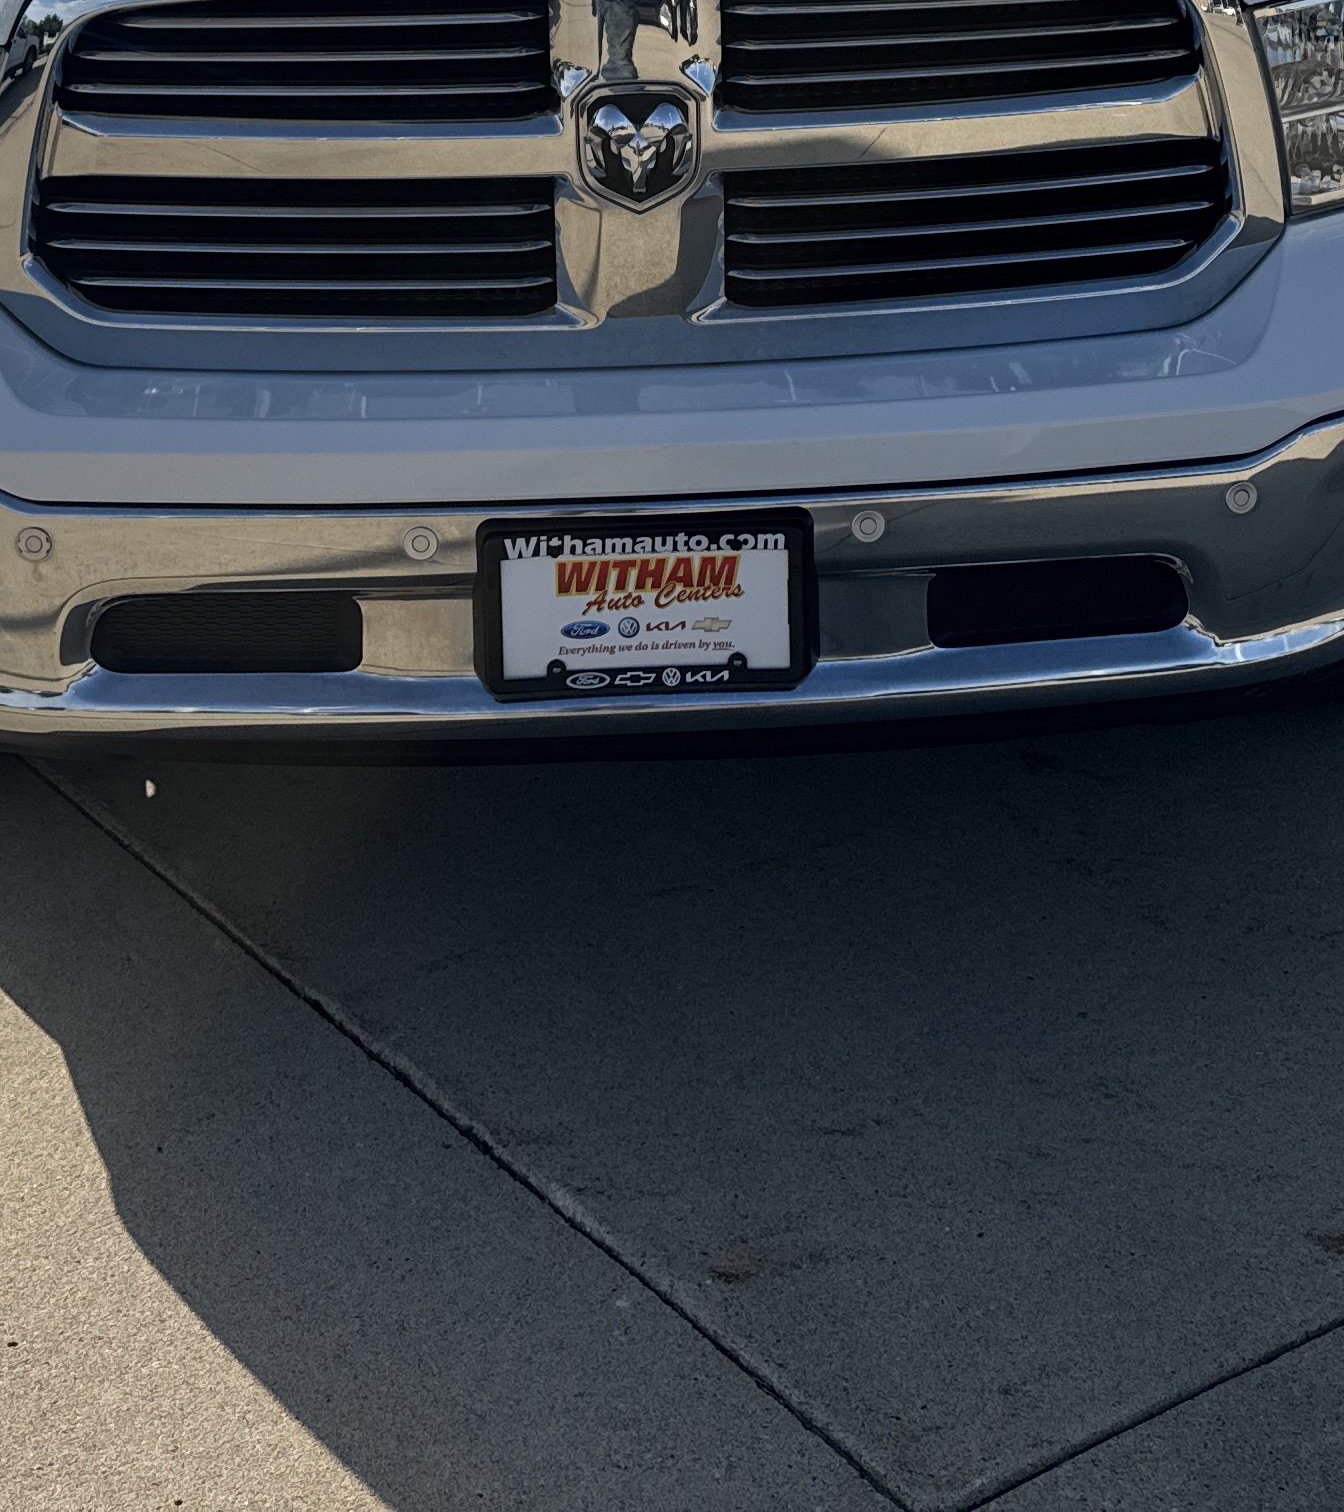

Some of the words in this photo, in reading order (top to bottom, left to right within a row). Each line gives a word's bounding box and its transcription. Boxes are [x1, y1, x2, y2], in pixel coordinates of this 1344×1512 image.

[556, 555, 742, 597] WITHAM
[581, 590, 645, 616] Auto
[654, 582, 746, 609] Centers
[558, 644, 616, 656] Everything
[619, 644, 633, 652] we
[635, 641, 649, 651] do
[651, 641, 659, 650] is
[662, 640, 696, 650] driven
[699, 639, 711, 651] by
